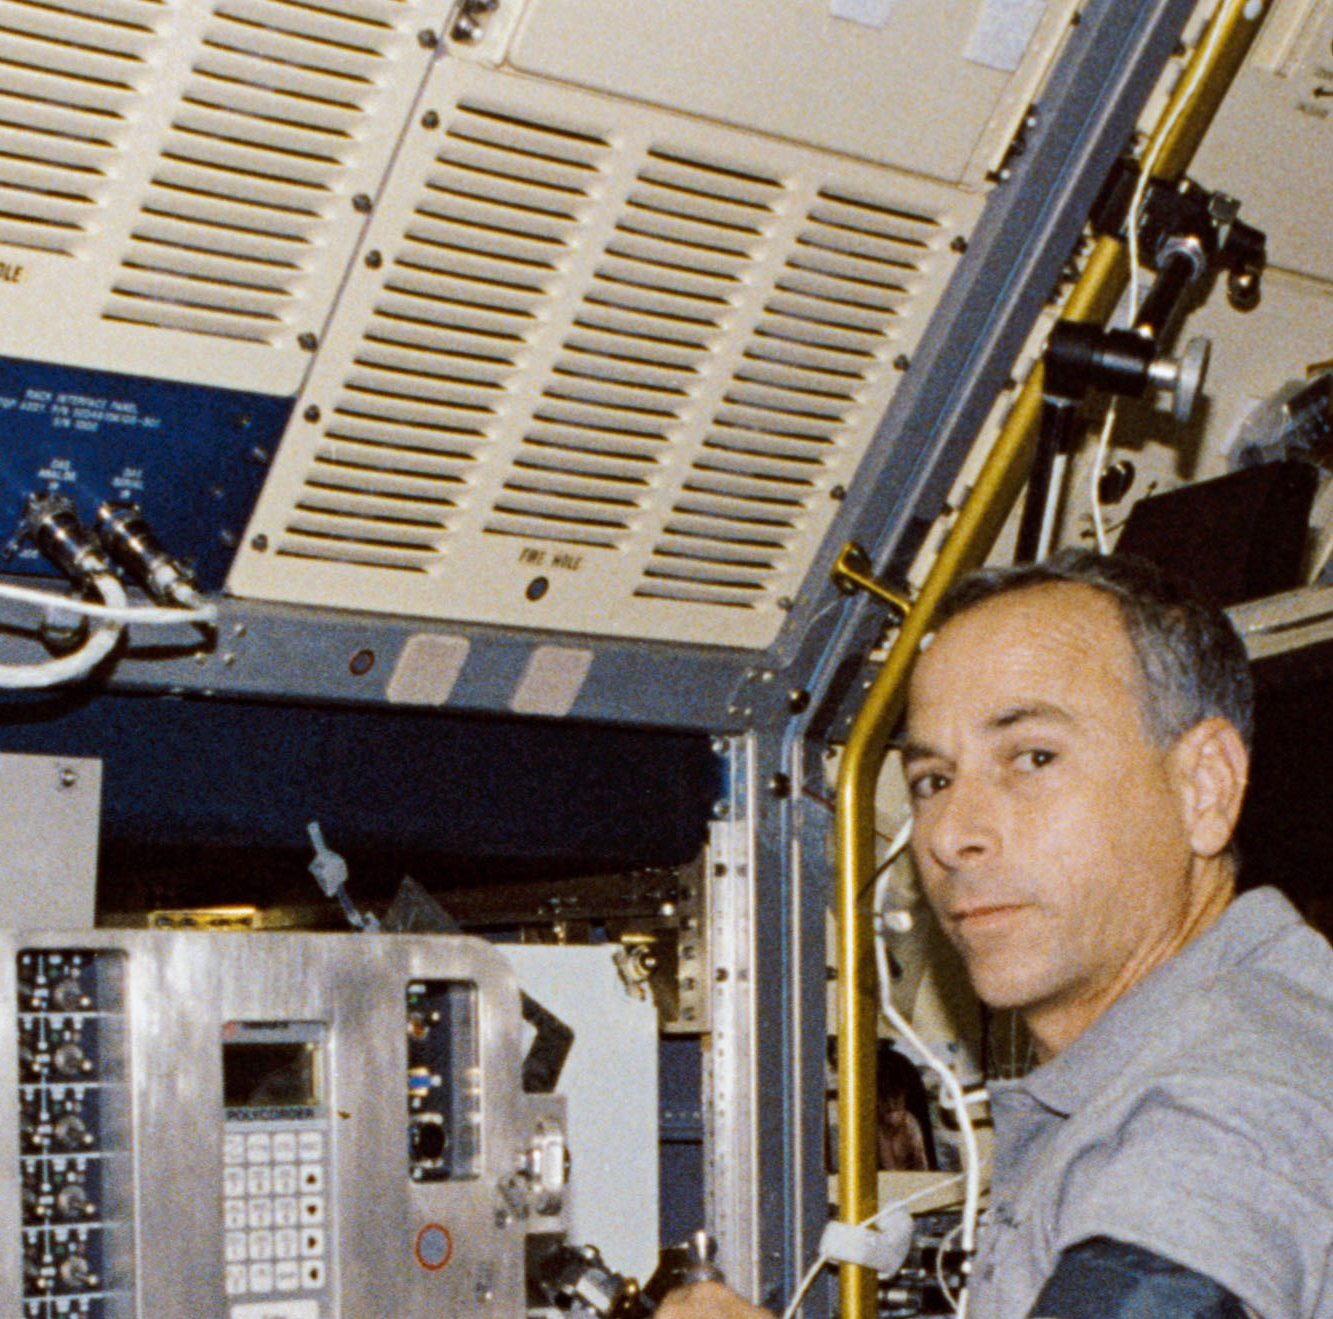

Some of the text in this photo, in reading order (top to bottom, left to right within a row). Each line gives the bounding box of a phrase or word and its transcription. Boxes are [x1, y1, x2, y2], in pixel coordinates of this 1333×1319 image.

[517, 547, 584, 572] FIRE HOLE
[225, 1106, 314, 1121] POLYCORDER
